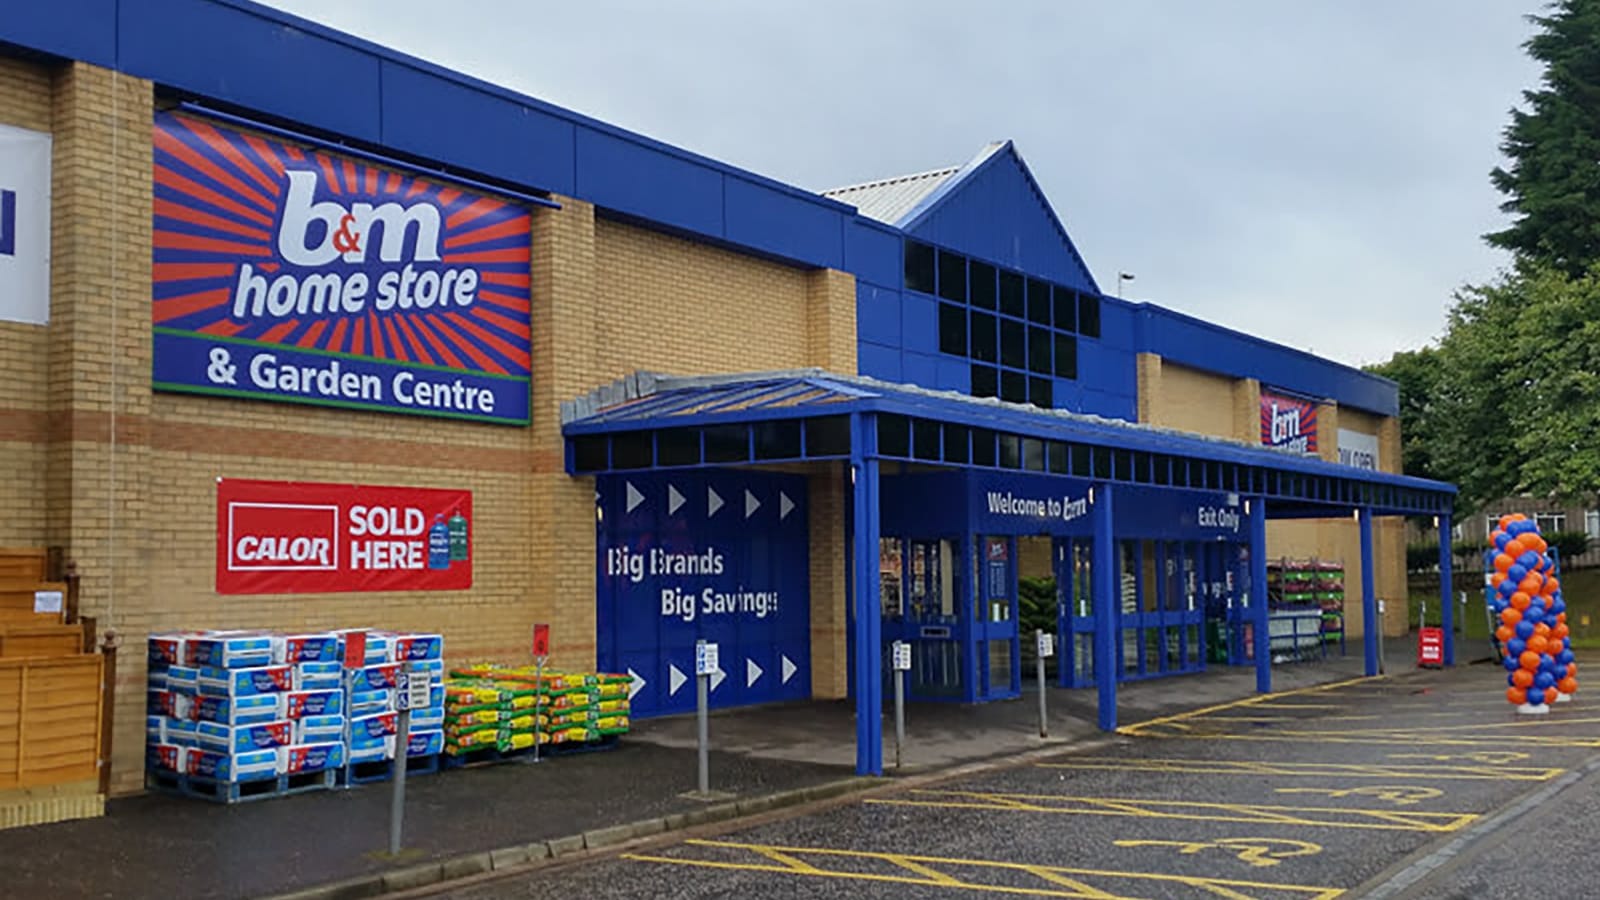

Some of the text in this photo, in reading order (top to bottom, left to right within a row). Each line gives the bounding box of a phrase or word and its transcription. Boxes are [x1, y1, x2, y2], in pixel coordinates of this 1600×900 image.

[278, 170, 442, 266] b&m
[233, 263, 479, 317] home store
[207, 347, 495, 413] & Garden Centre
[987, 491, 1045, 516] Welcome
[1047, 497, 1061, 517] to
[1198, 506, 1240, 533] Exit Only
[349, 505, 425, 536] SOLD
[236, 535, 330, 566] CALOR
[350, 541, 424, 570] HERE
[661, 587, 696, 622] Big
